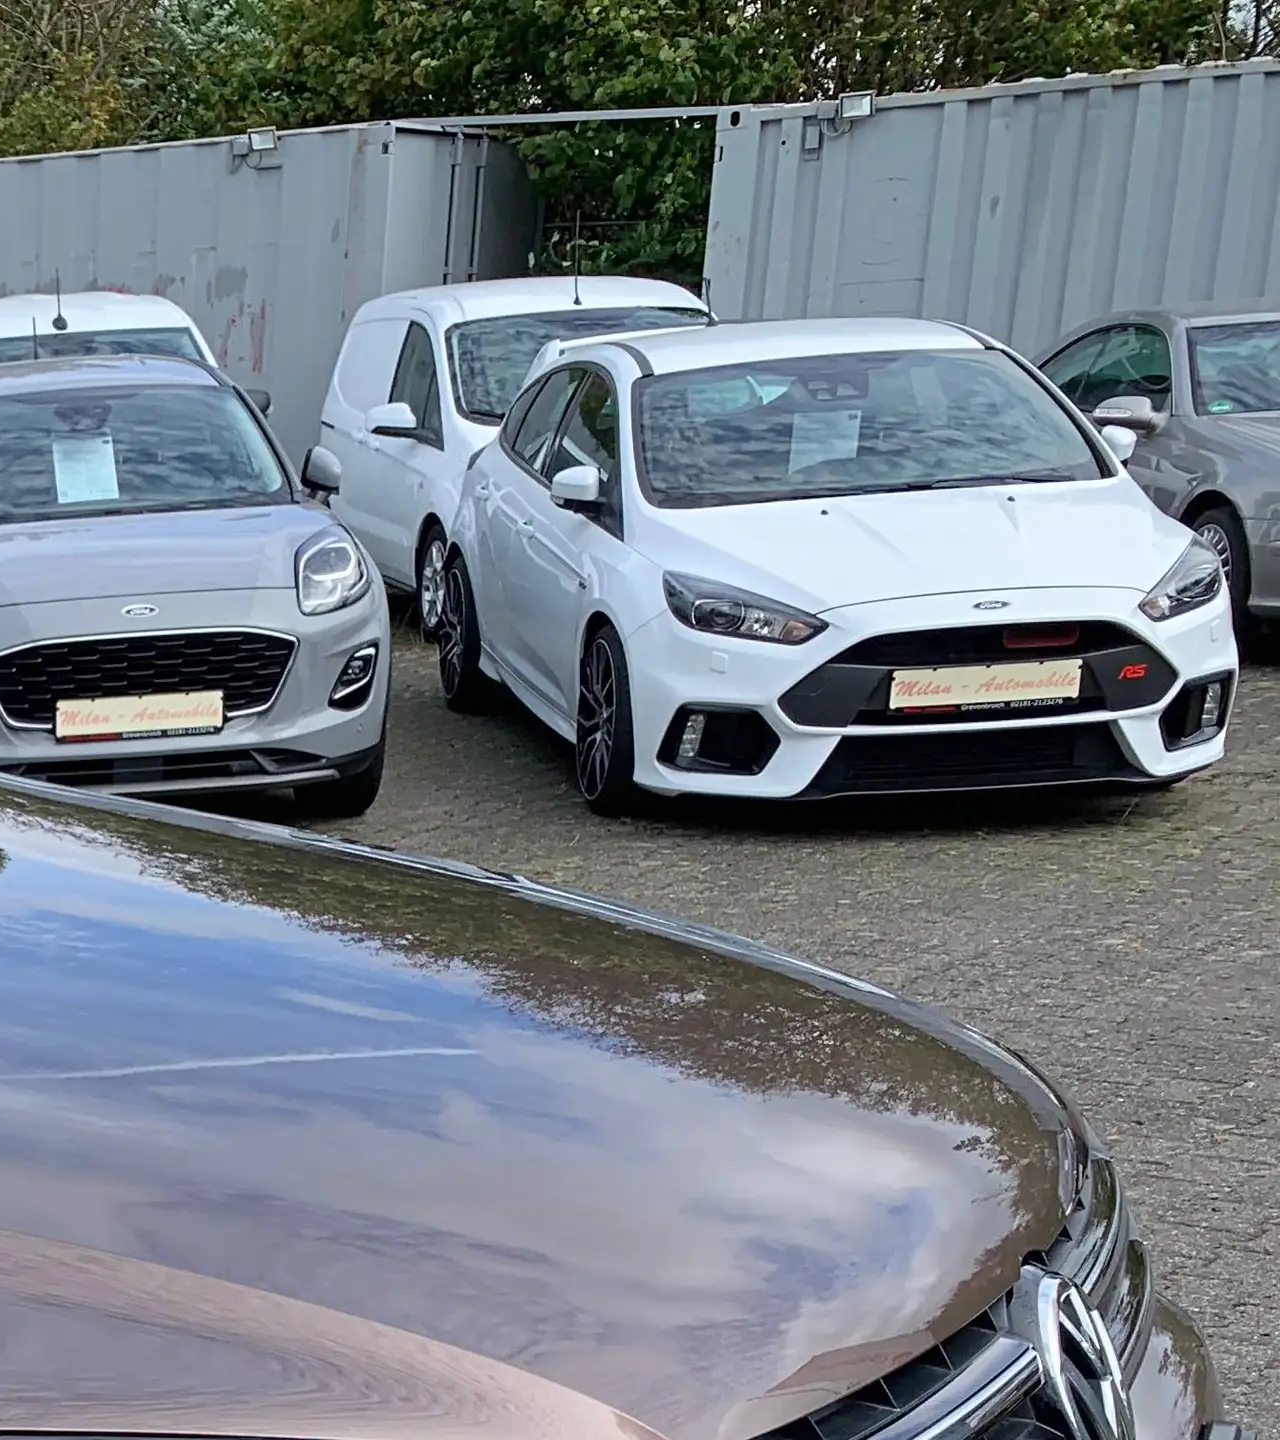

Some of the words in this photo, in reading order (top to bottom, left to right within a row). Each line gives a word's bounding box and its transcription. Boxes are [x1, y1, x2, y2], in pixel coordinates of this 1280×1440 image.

[1117, 664, 1148, 680] RS
[895, 680, 952, 697] Milan
[974, 672, 1077, 695] Automobile
[59, 708, 110, 726] Milan
[130, 703, 220, 723] Automobile
